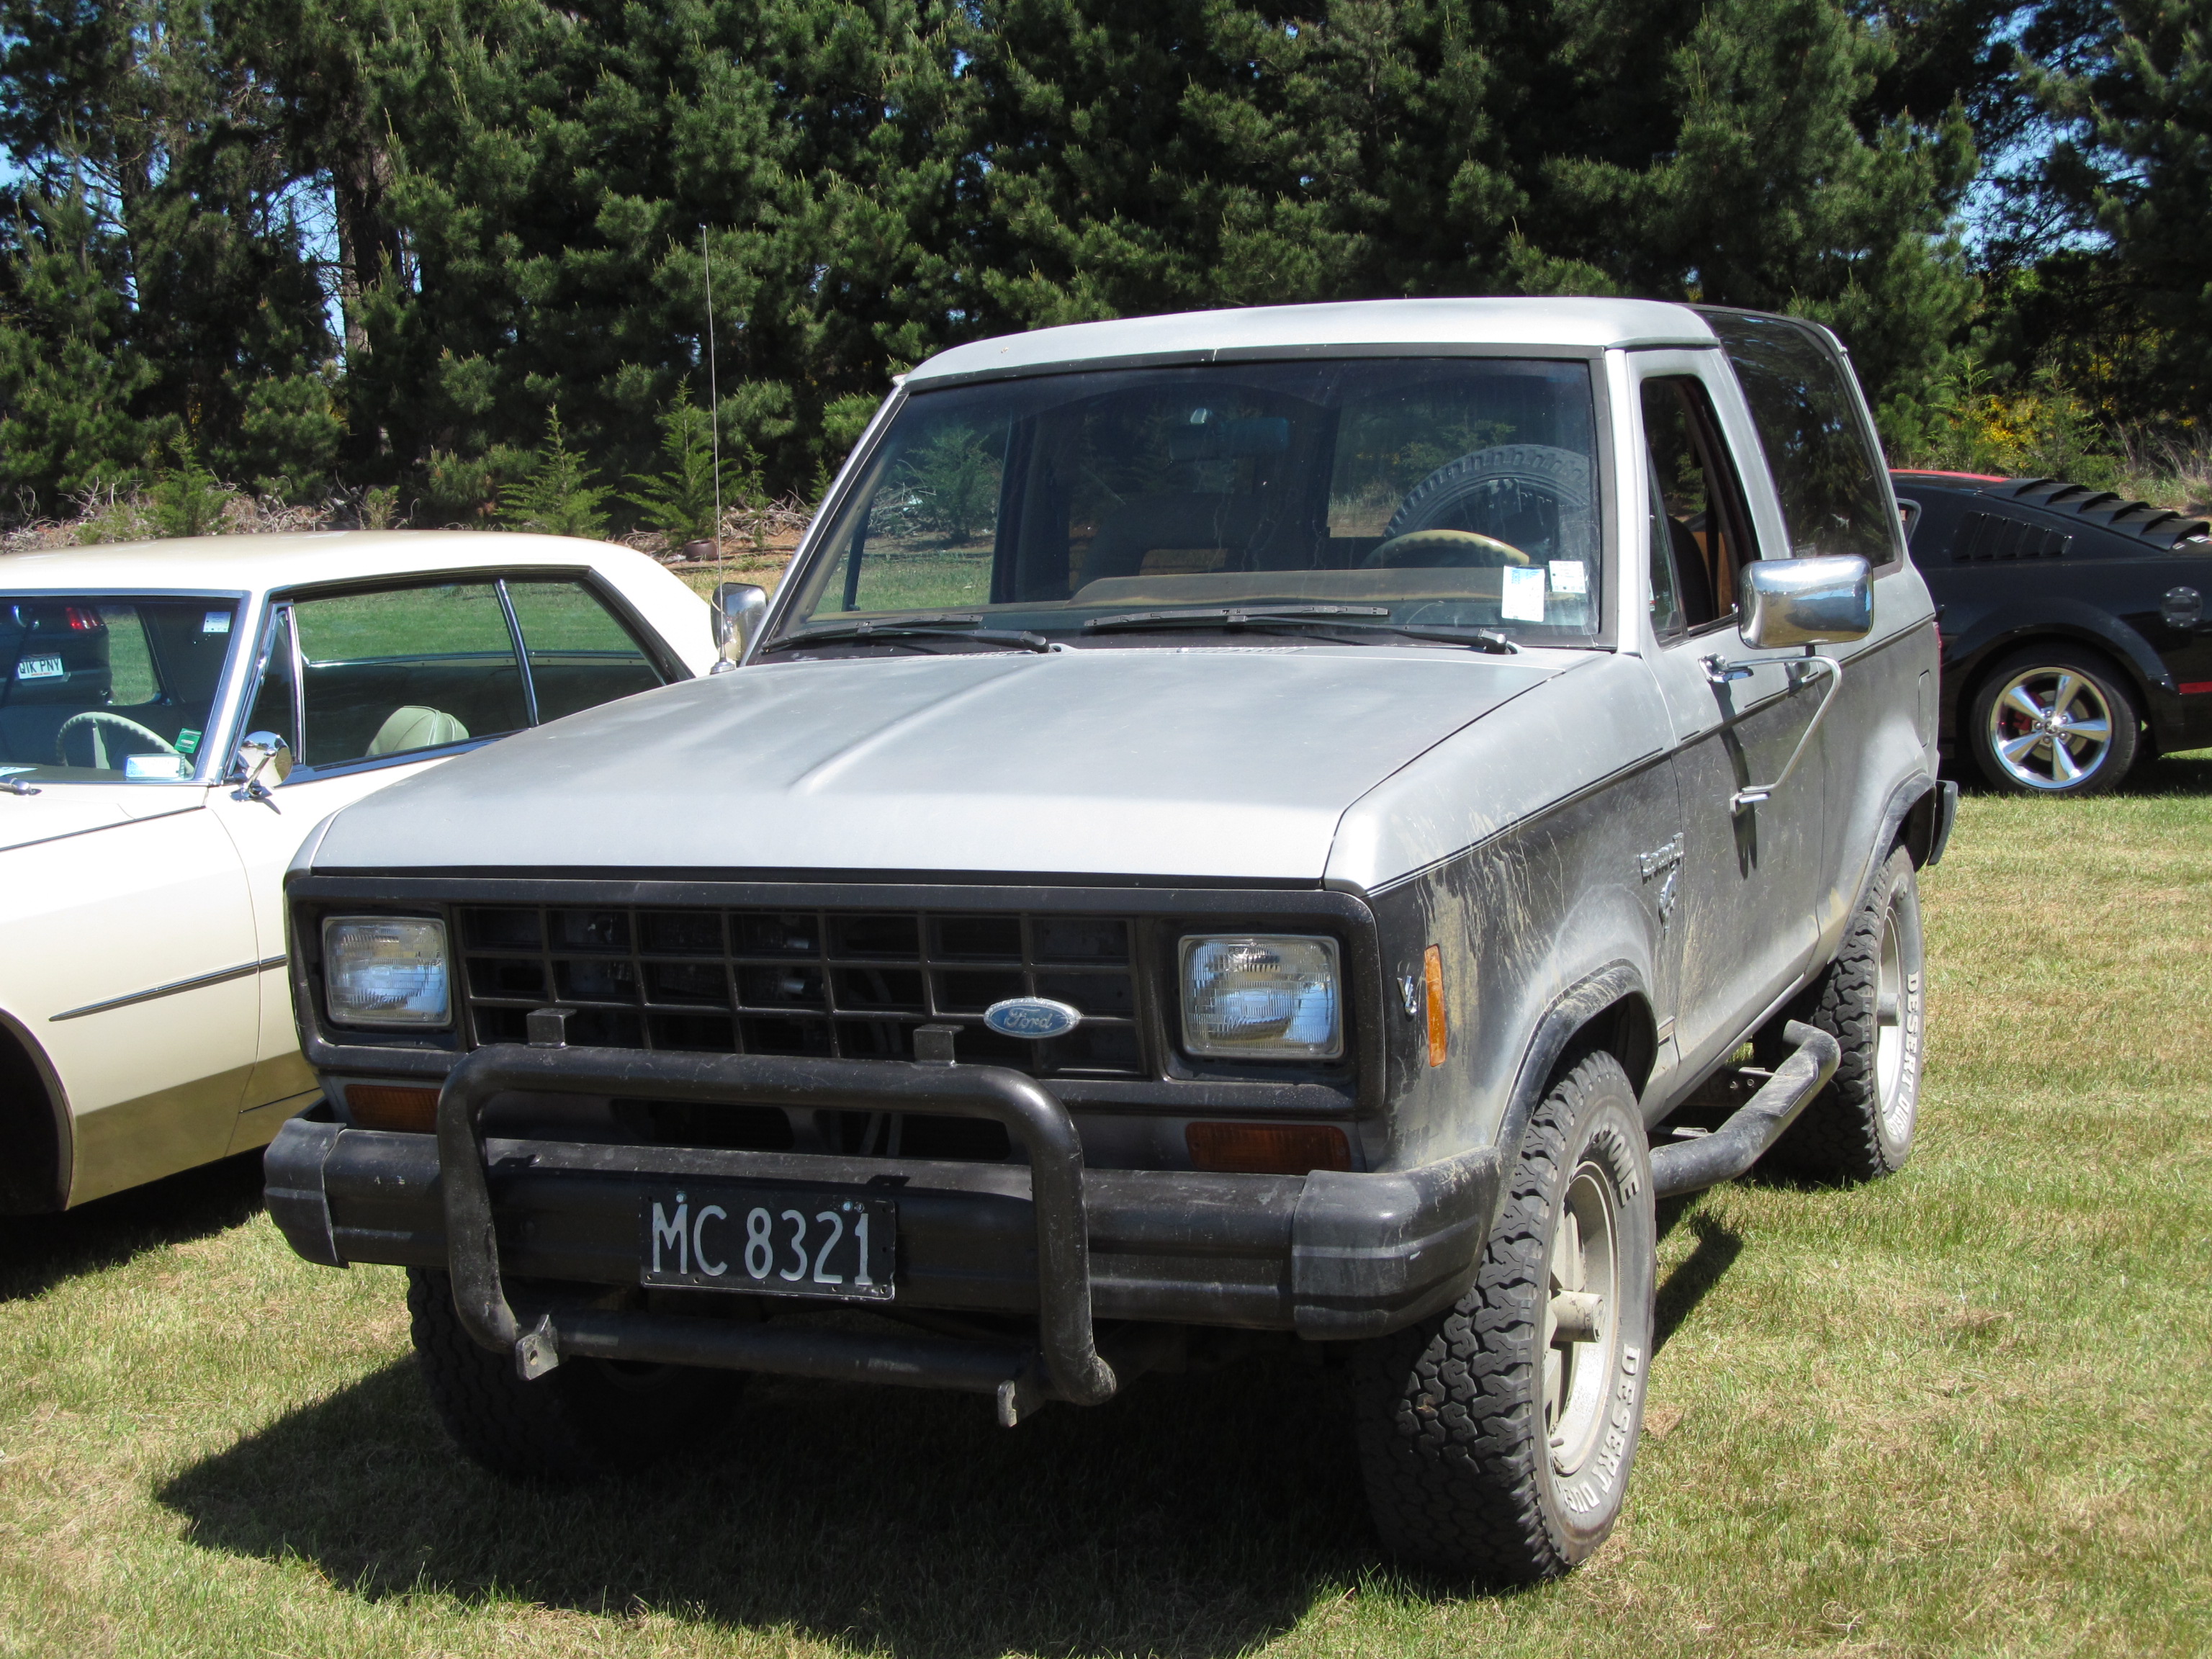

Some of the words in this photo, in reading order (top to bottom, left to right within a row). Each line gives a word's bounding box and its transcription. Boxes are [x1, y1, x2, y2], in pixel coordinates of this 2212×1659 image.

[39, 658, 59, 672] PNY
[1004, 1007, 1053, 1029] Ford
[1902, 971, 1919, 1093] DESERT
[1586, 1122, 1640, 1207] STONE
[652, 1201, 728, 1277] MC
[745, 1207, 873, 1286] 8321
[1591, 1344, 1641, 1493] DESERT
